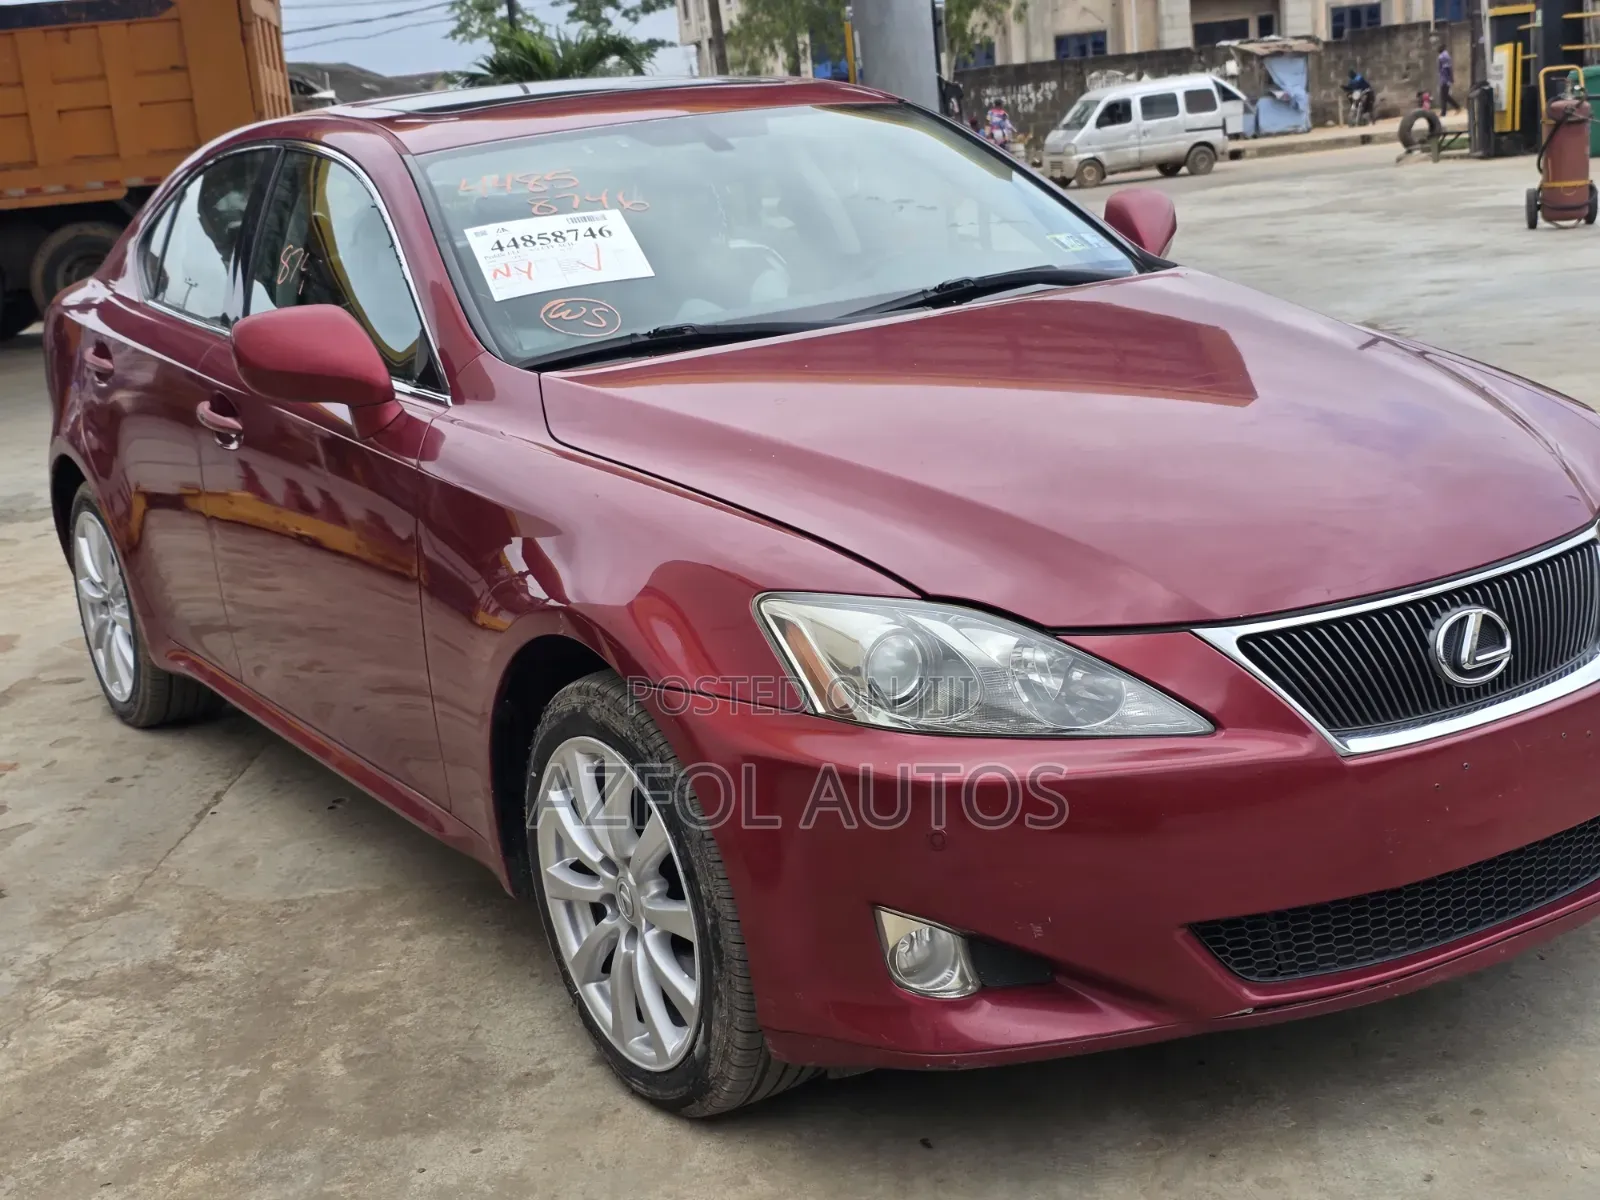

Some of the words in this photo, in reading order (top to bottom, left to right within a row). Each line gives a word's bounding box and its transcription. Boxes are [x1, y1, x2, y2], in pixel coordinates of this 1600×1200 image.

[459, 169, 579, 198] 4485
[527, 189, 650, 215] 8746
[490, 224, 613, 252] 44858746
